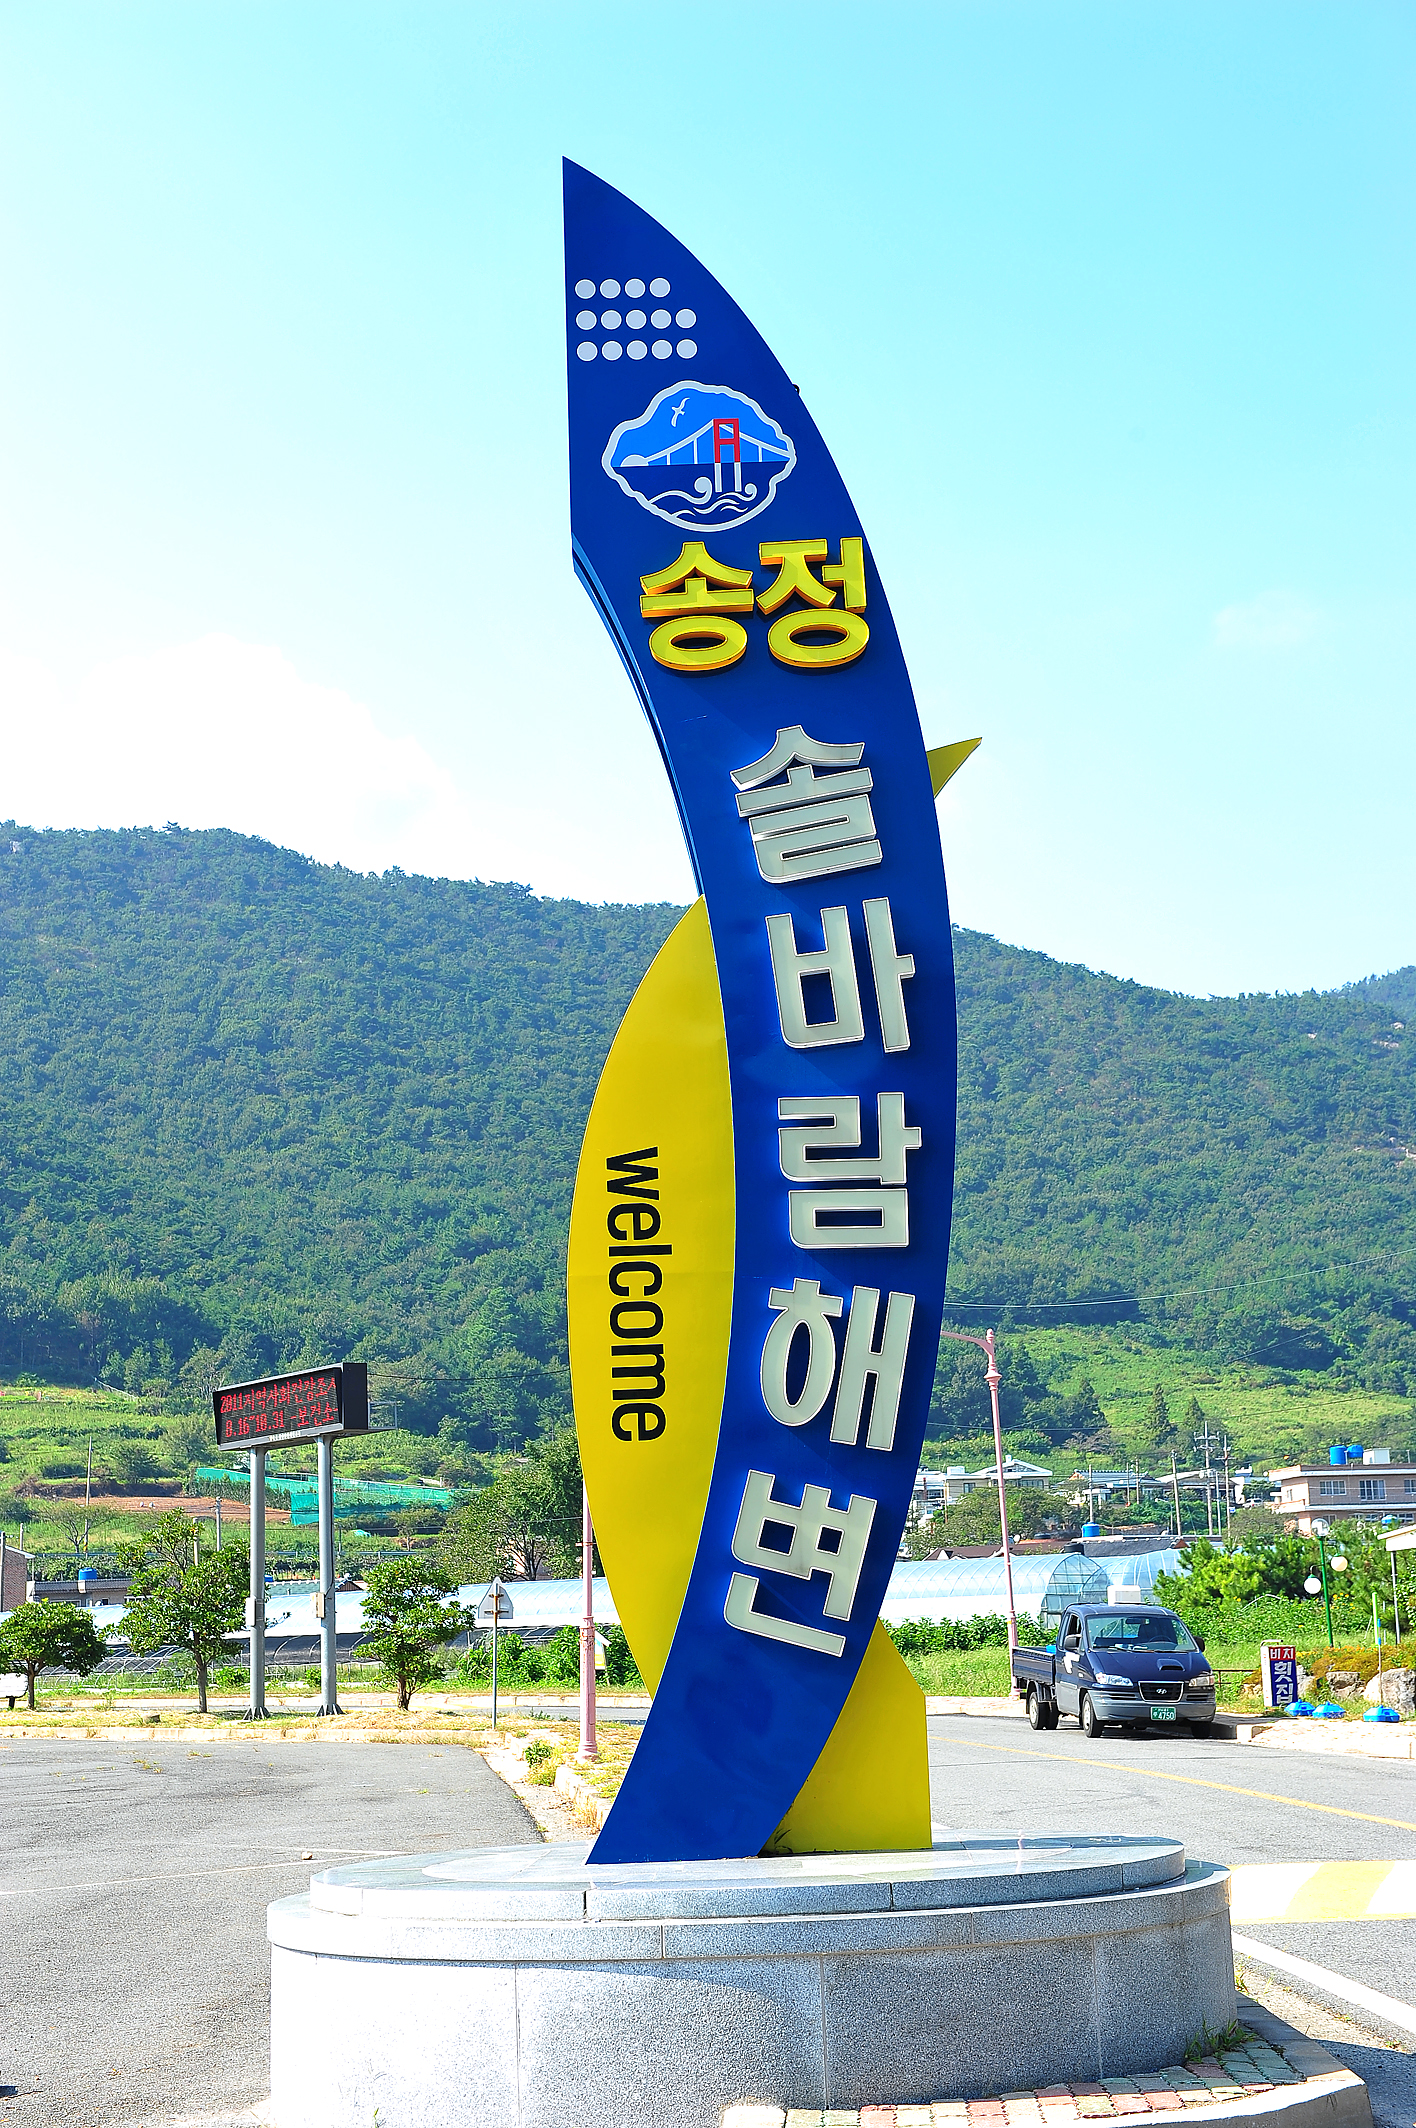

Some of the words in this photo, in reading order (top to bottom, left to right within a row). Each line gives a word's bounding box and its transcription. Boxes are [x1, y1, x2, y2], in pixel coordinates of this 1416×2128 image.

[639, 537, 870, 671] 송정
[724, 725, 922, 1657] 솔바람해변
[606, 1146, 673, 1443] welcome
[1270, 1647, 1294, 1660] 비치
[1274, 1661, 1294, 1704] 횟집
